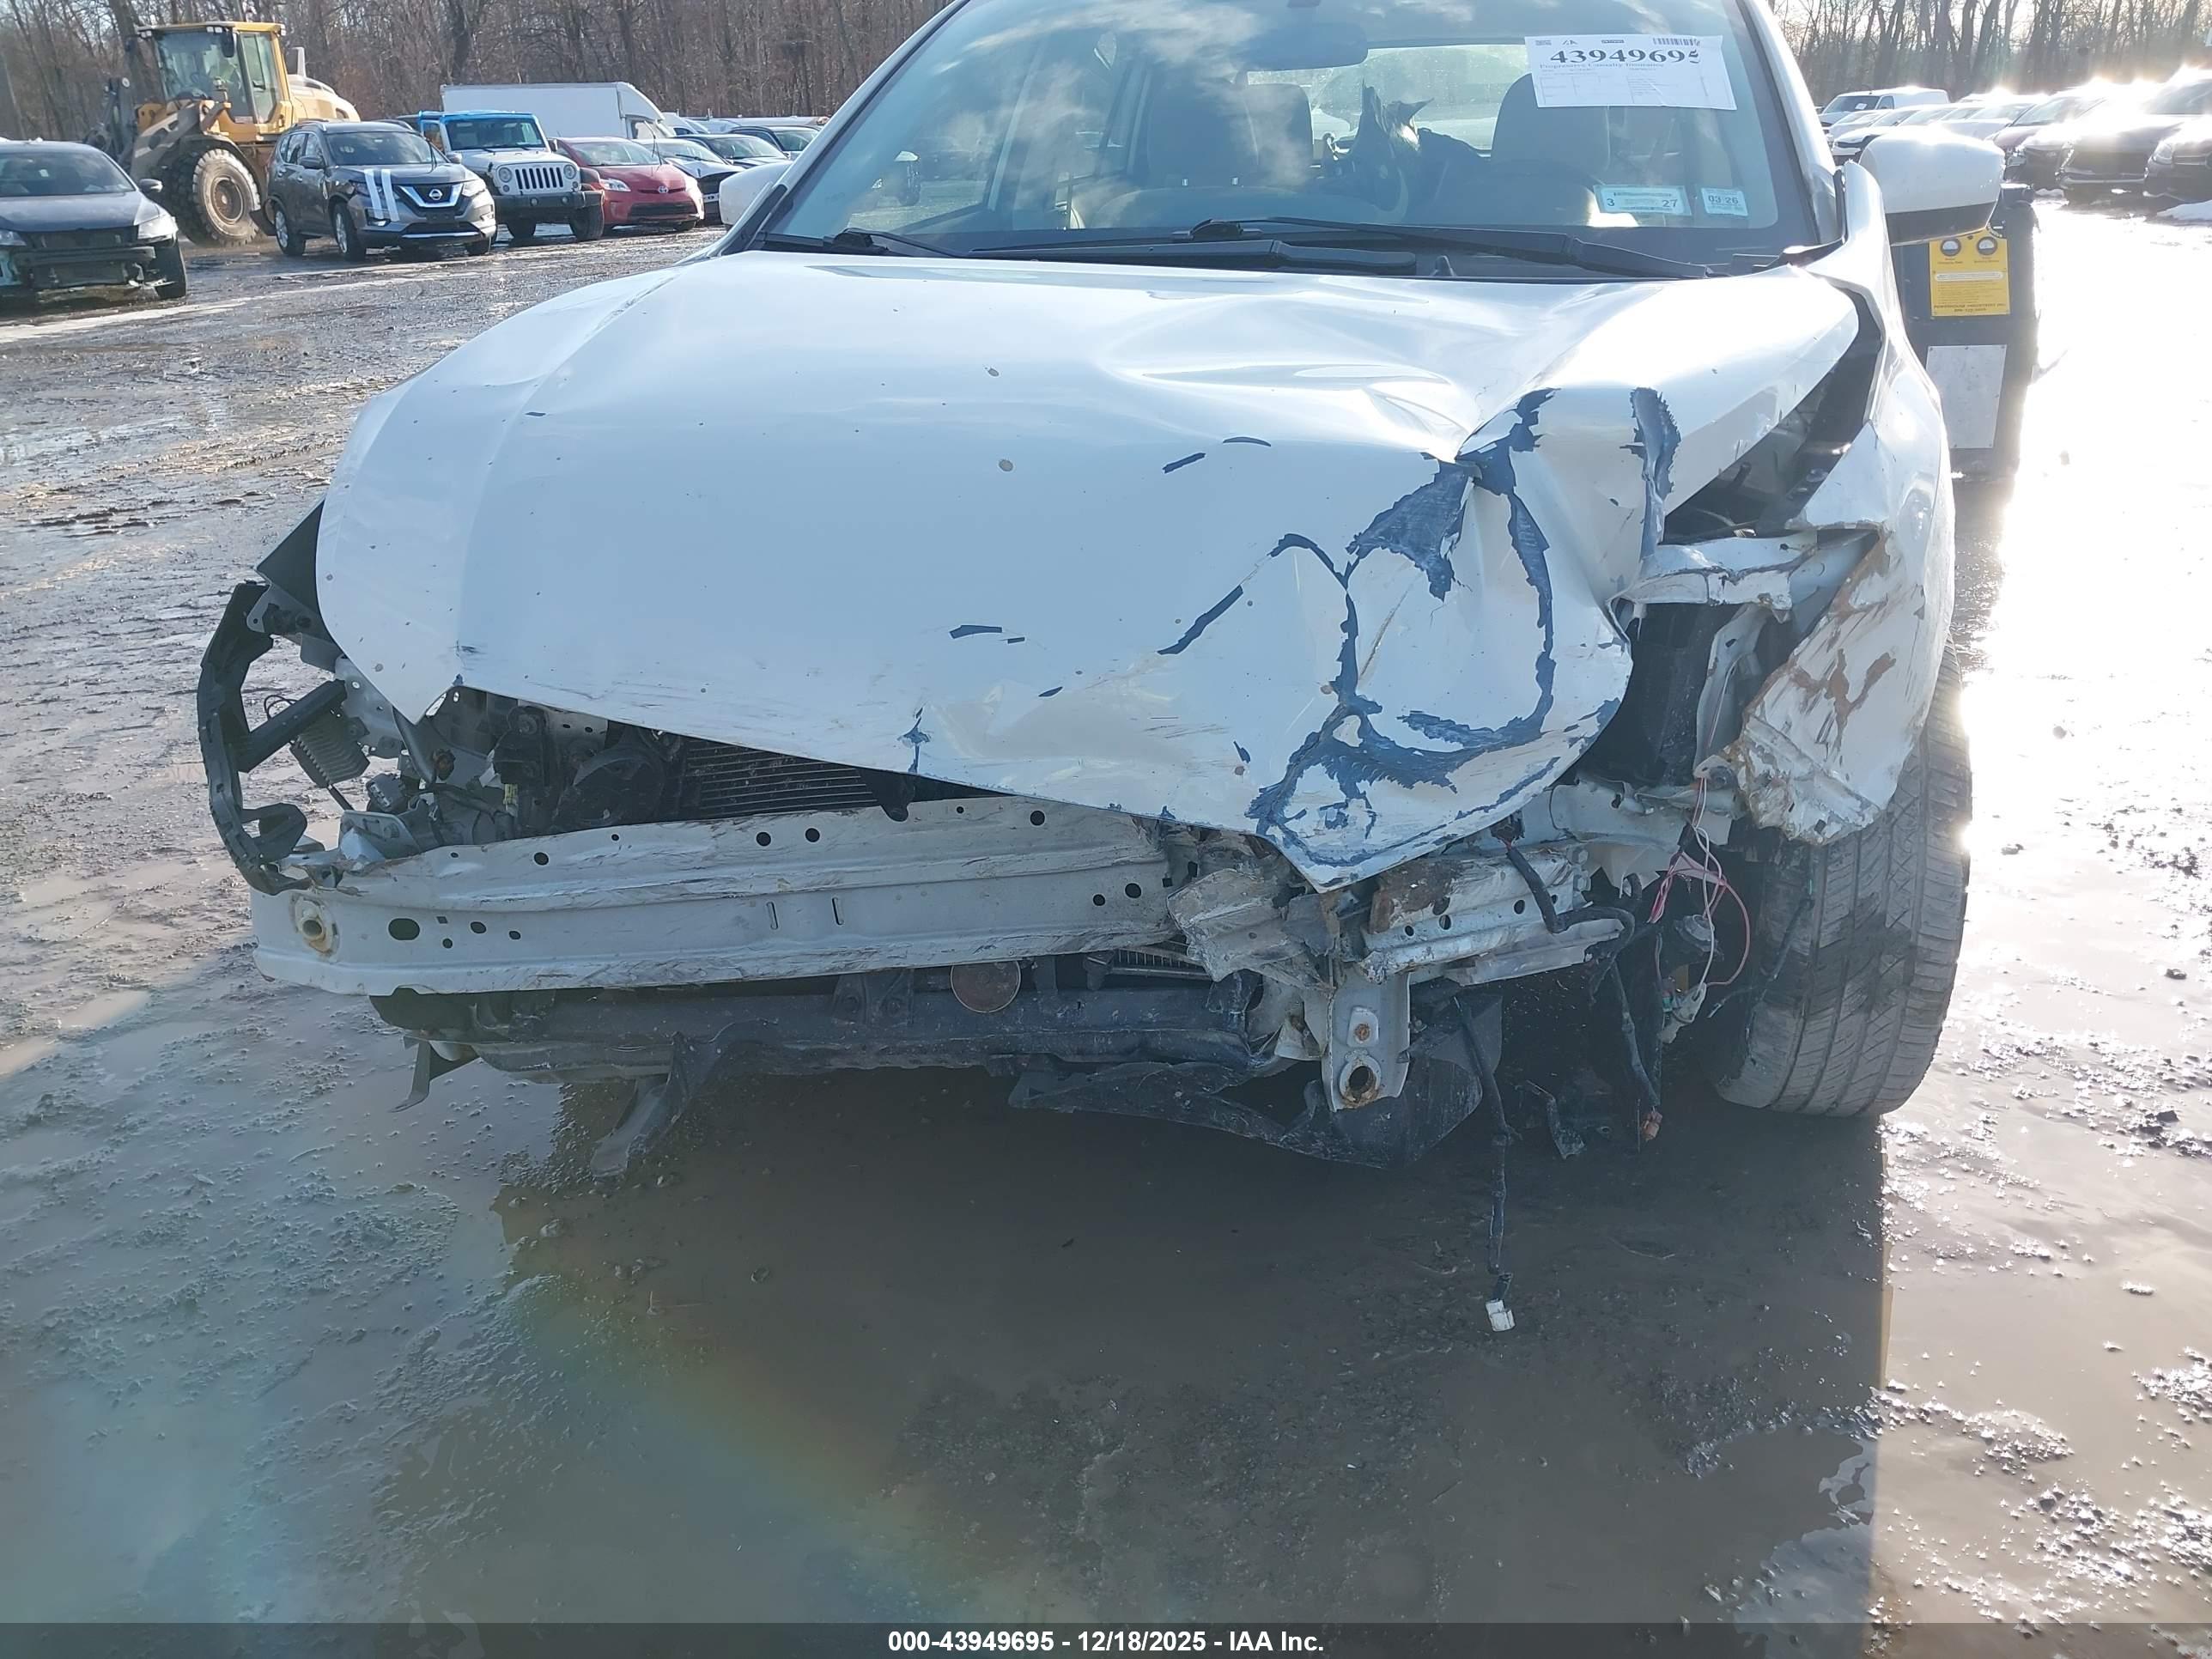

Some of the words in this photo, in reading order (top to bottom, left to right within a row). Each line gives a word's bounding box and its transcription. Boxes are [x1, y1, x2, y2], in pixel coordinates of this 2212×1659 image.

[1607, 198, 1615, 207] 3
[1662, 198, 1678, 208] 27
[1708, 194, 1722, 204] 03
[1725, 196, 1739, 205] 26
